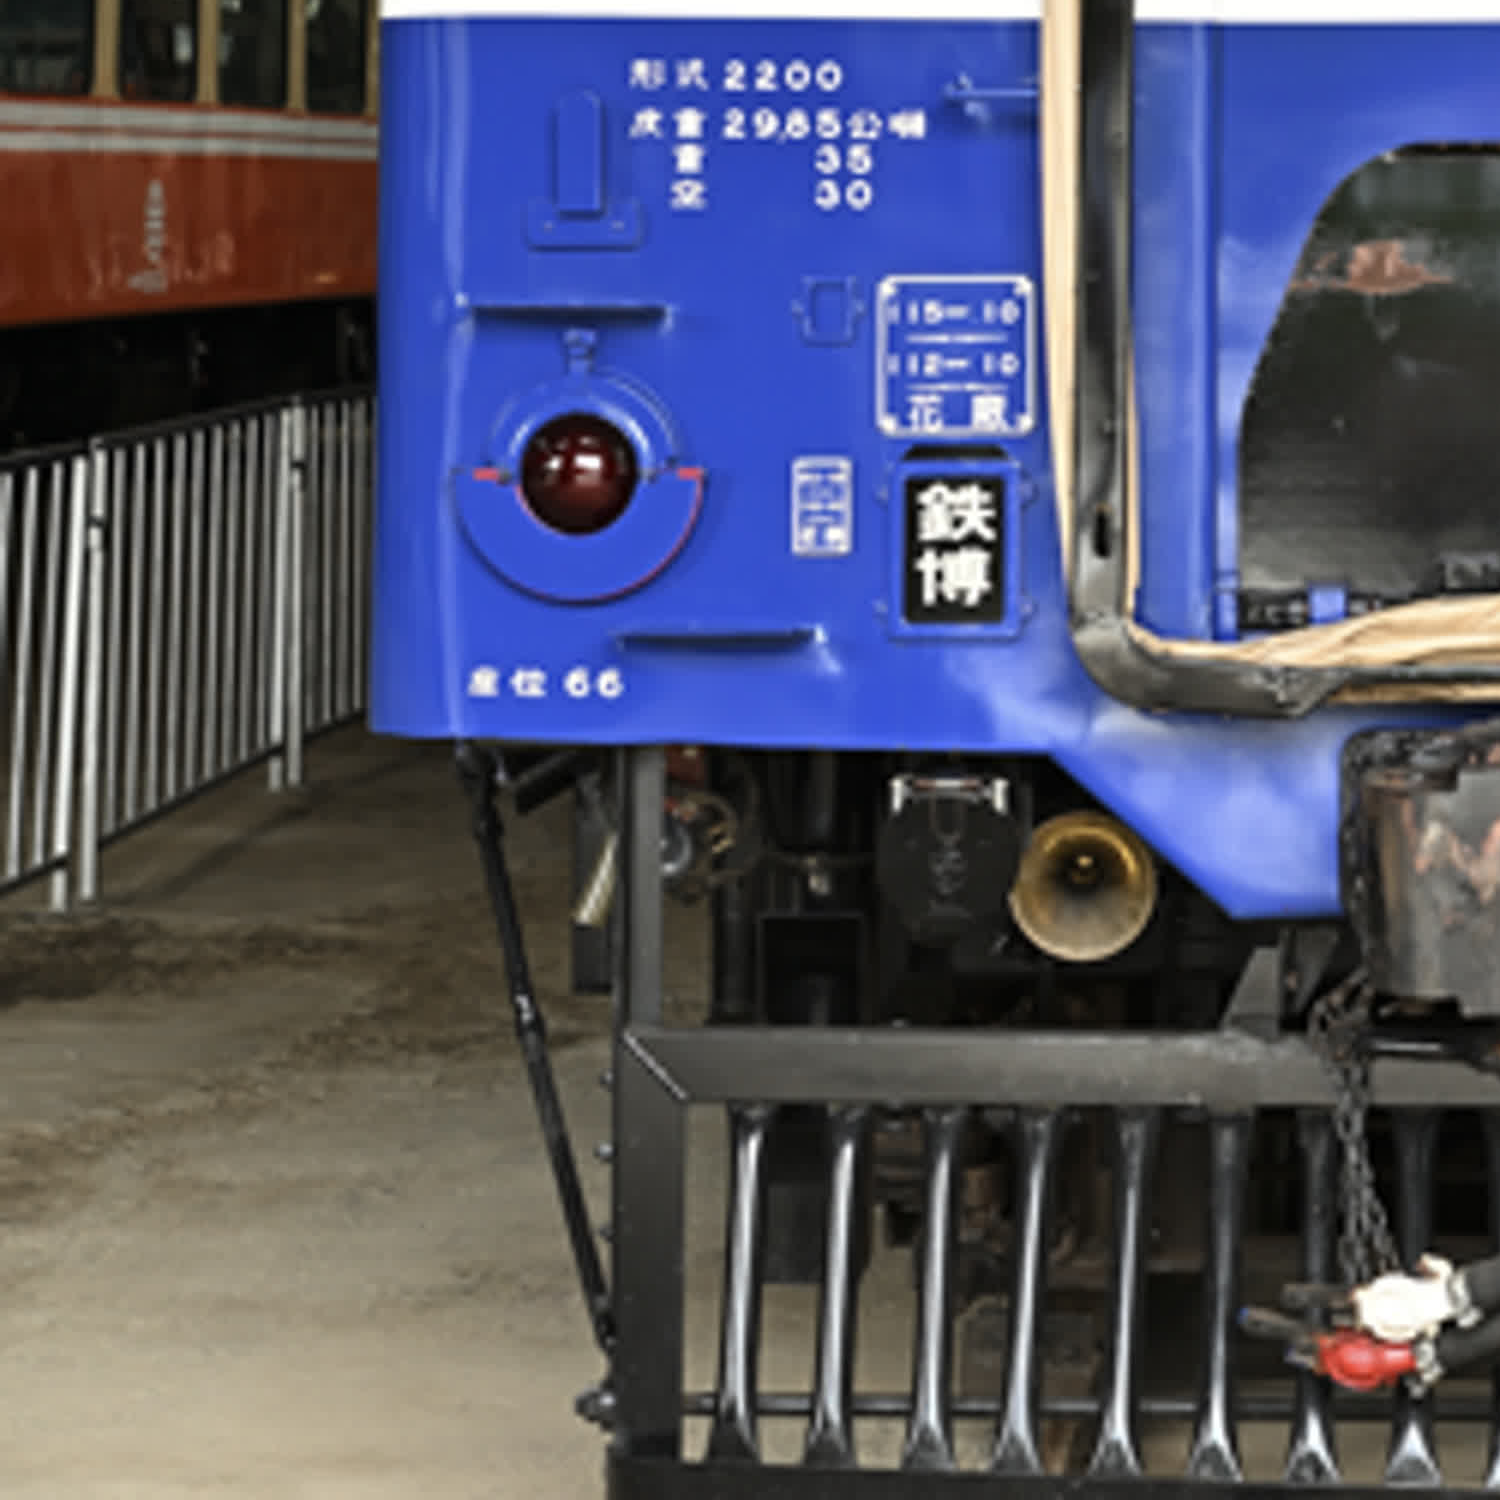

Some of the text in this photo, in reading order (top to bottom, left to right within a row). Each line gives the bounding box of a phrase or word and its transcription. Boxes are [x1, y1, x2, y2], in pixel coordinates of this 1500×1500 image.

[723, 59, 844, 91] 2200
[814, 143, 873, 175] 35
[814, 178, 873, 211] 30
[564, 665, 625, 699] 66
